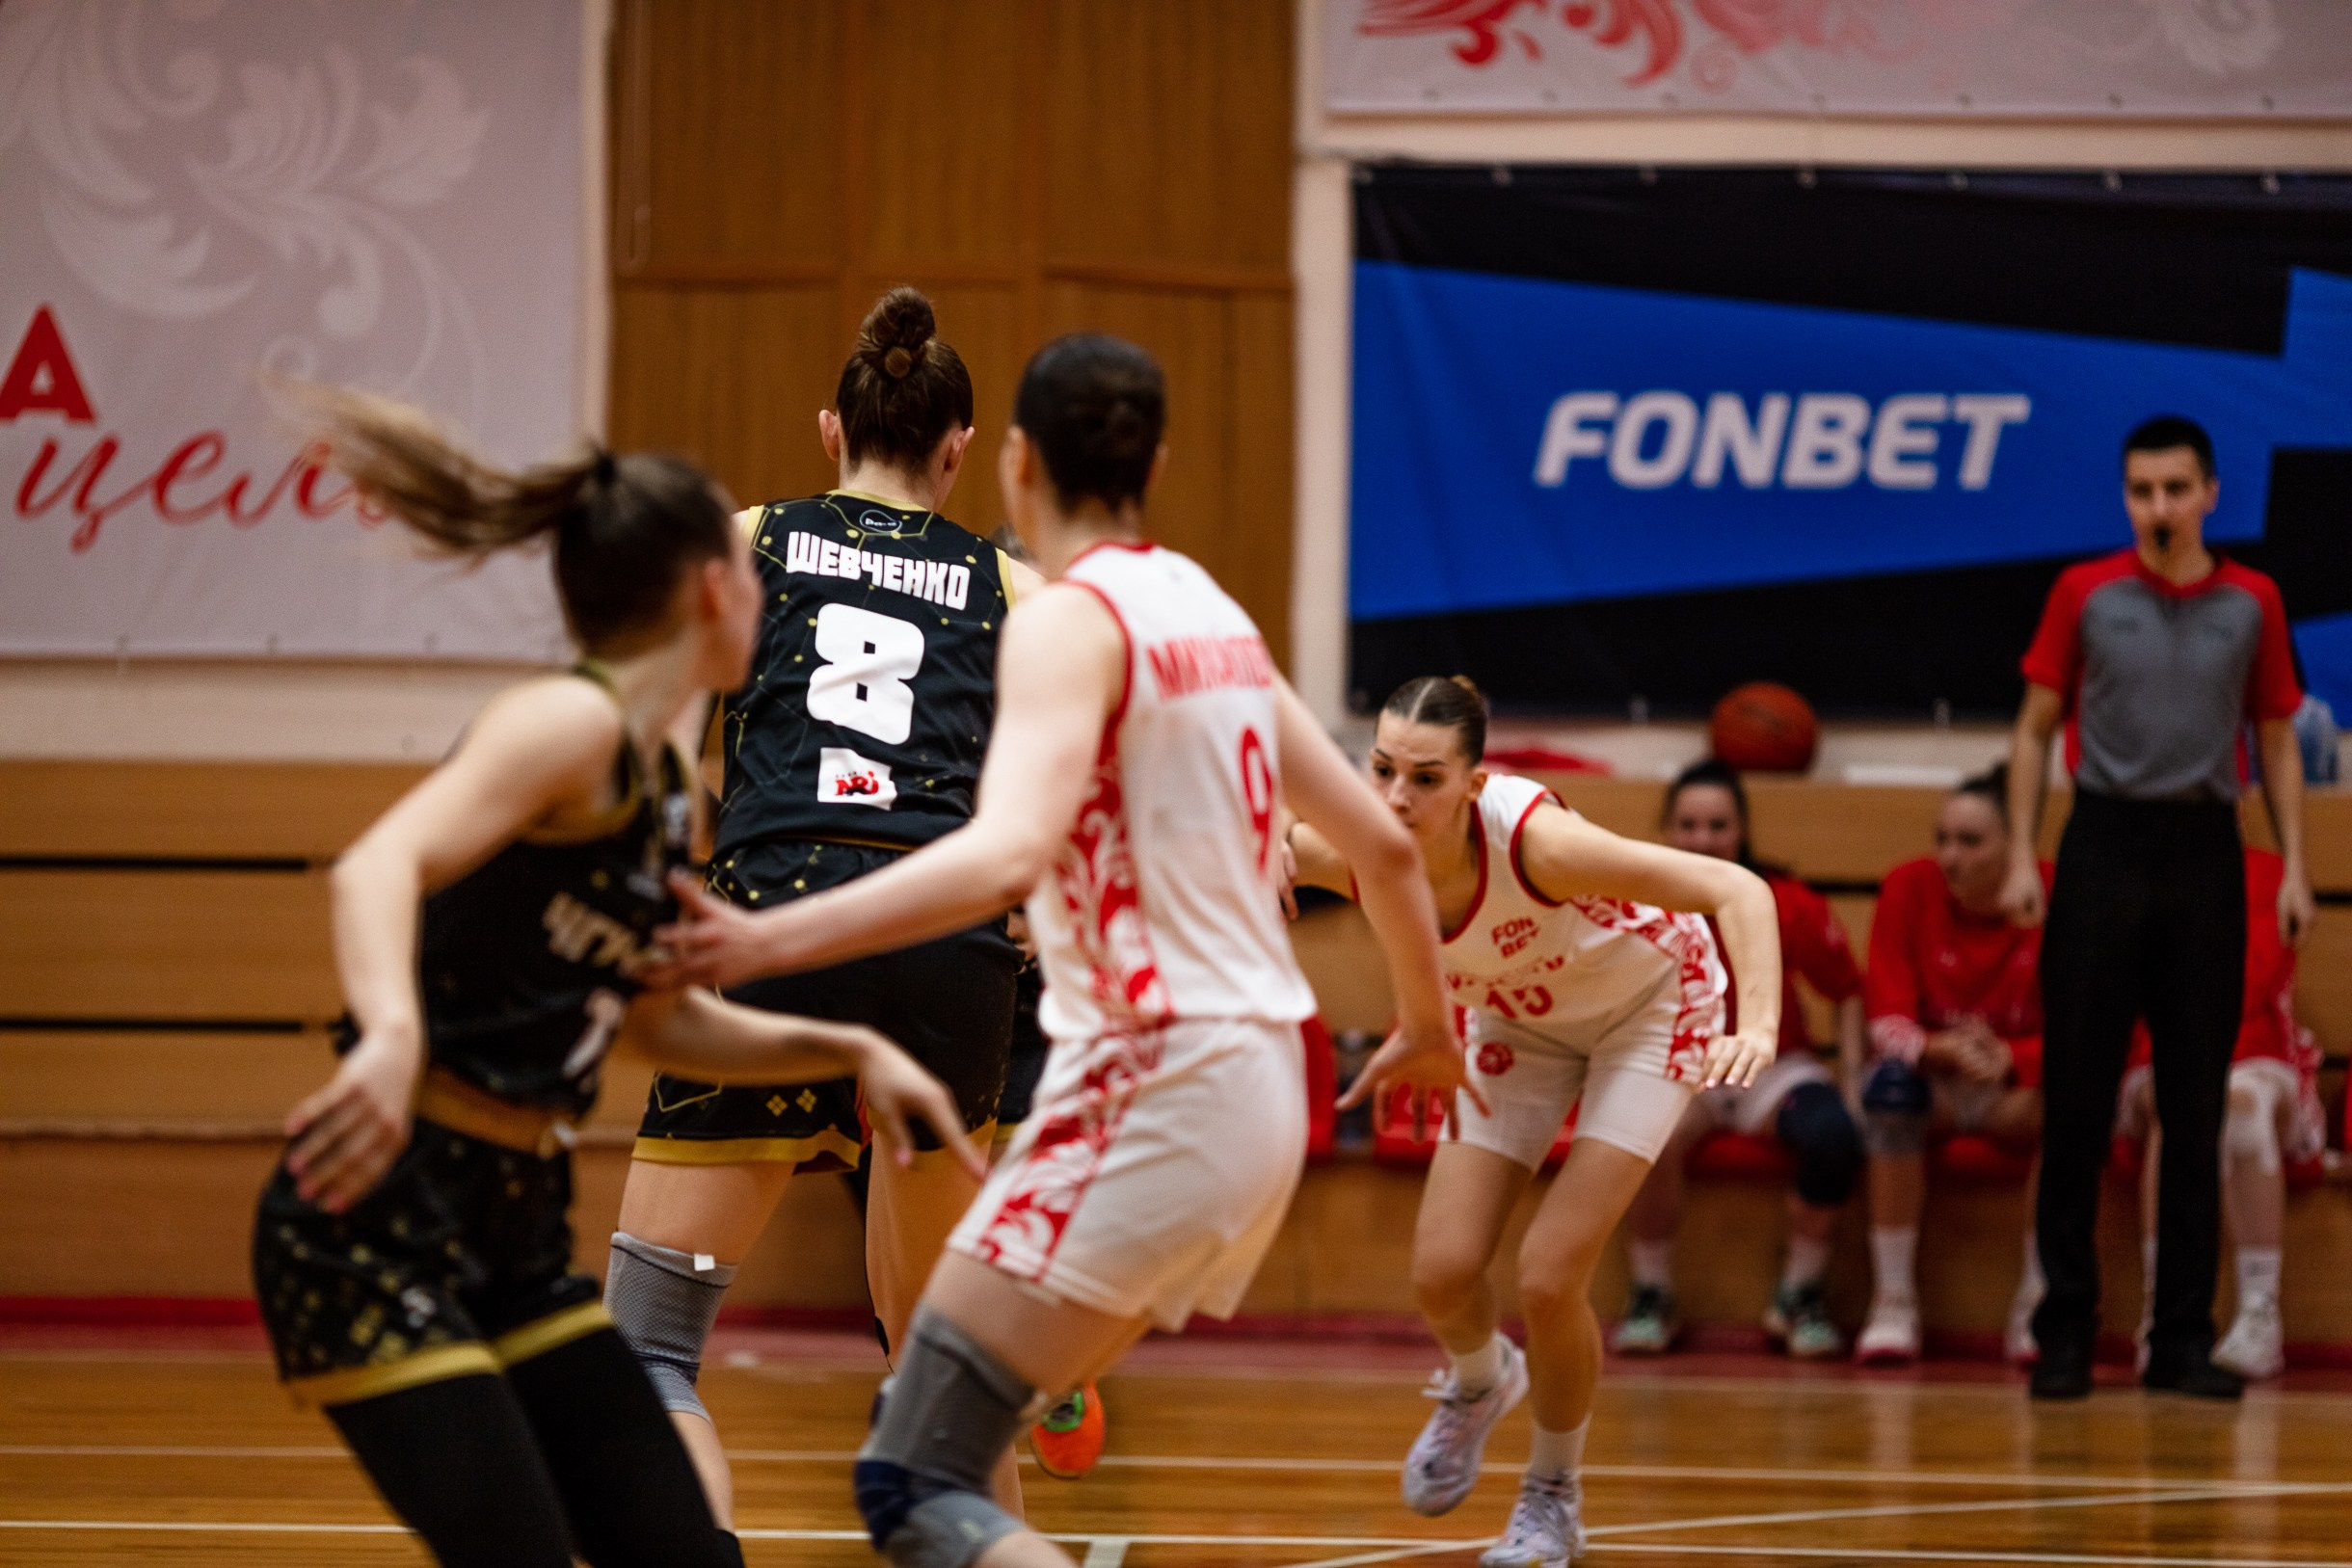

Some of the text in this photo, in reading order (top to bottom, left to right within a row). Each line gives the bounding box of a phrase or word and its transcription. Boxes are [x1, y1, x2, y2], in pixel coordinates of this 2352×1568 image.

[1535, 390, 2031, 490] FONBET
[786, 531, 971, 611] ШЕВЧЕНКО
[806, 602, 925, 746] 8
[1239, 726, 1274, 877] 9
[1491, 917, 1535, 945] FON
